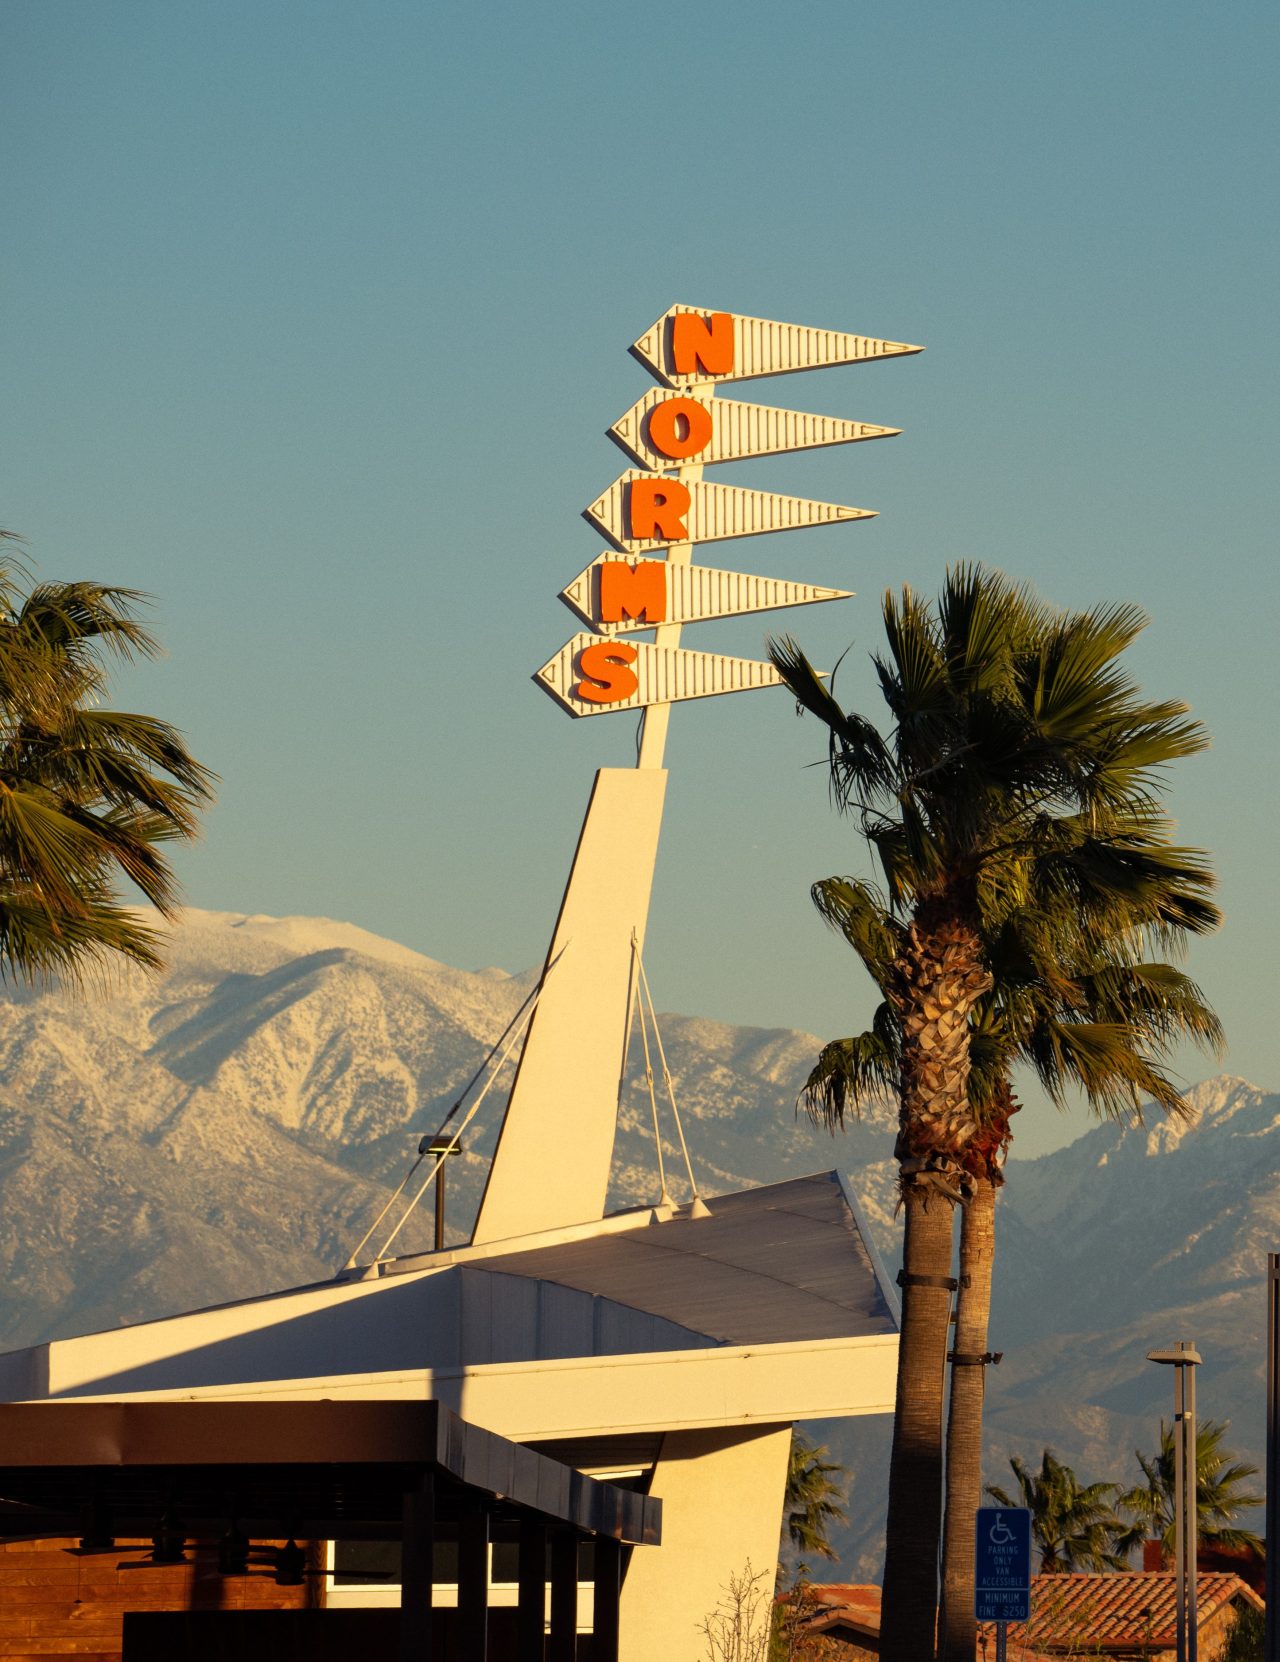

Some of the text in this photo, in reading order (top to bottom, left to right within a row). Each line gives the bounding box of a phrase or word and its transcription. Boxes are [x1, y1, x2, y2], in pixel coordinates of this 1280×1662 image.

[578, 313, 734, 703] NORMS
[987, 1546, 1019, 1555] PARKING
[993, 1556, 1013, 1565] ONLY
[996, 1566, 1010, 1575] VAN
[982, 1577, 1024, 1586] ACCESSIBLE
[985, 1592, 1020, 1603] MINIMUM
[979, 1606, 1025, 1616] FINE $250
